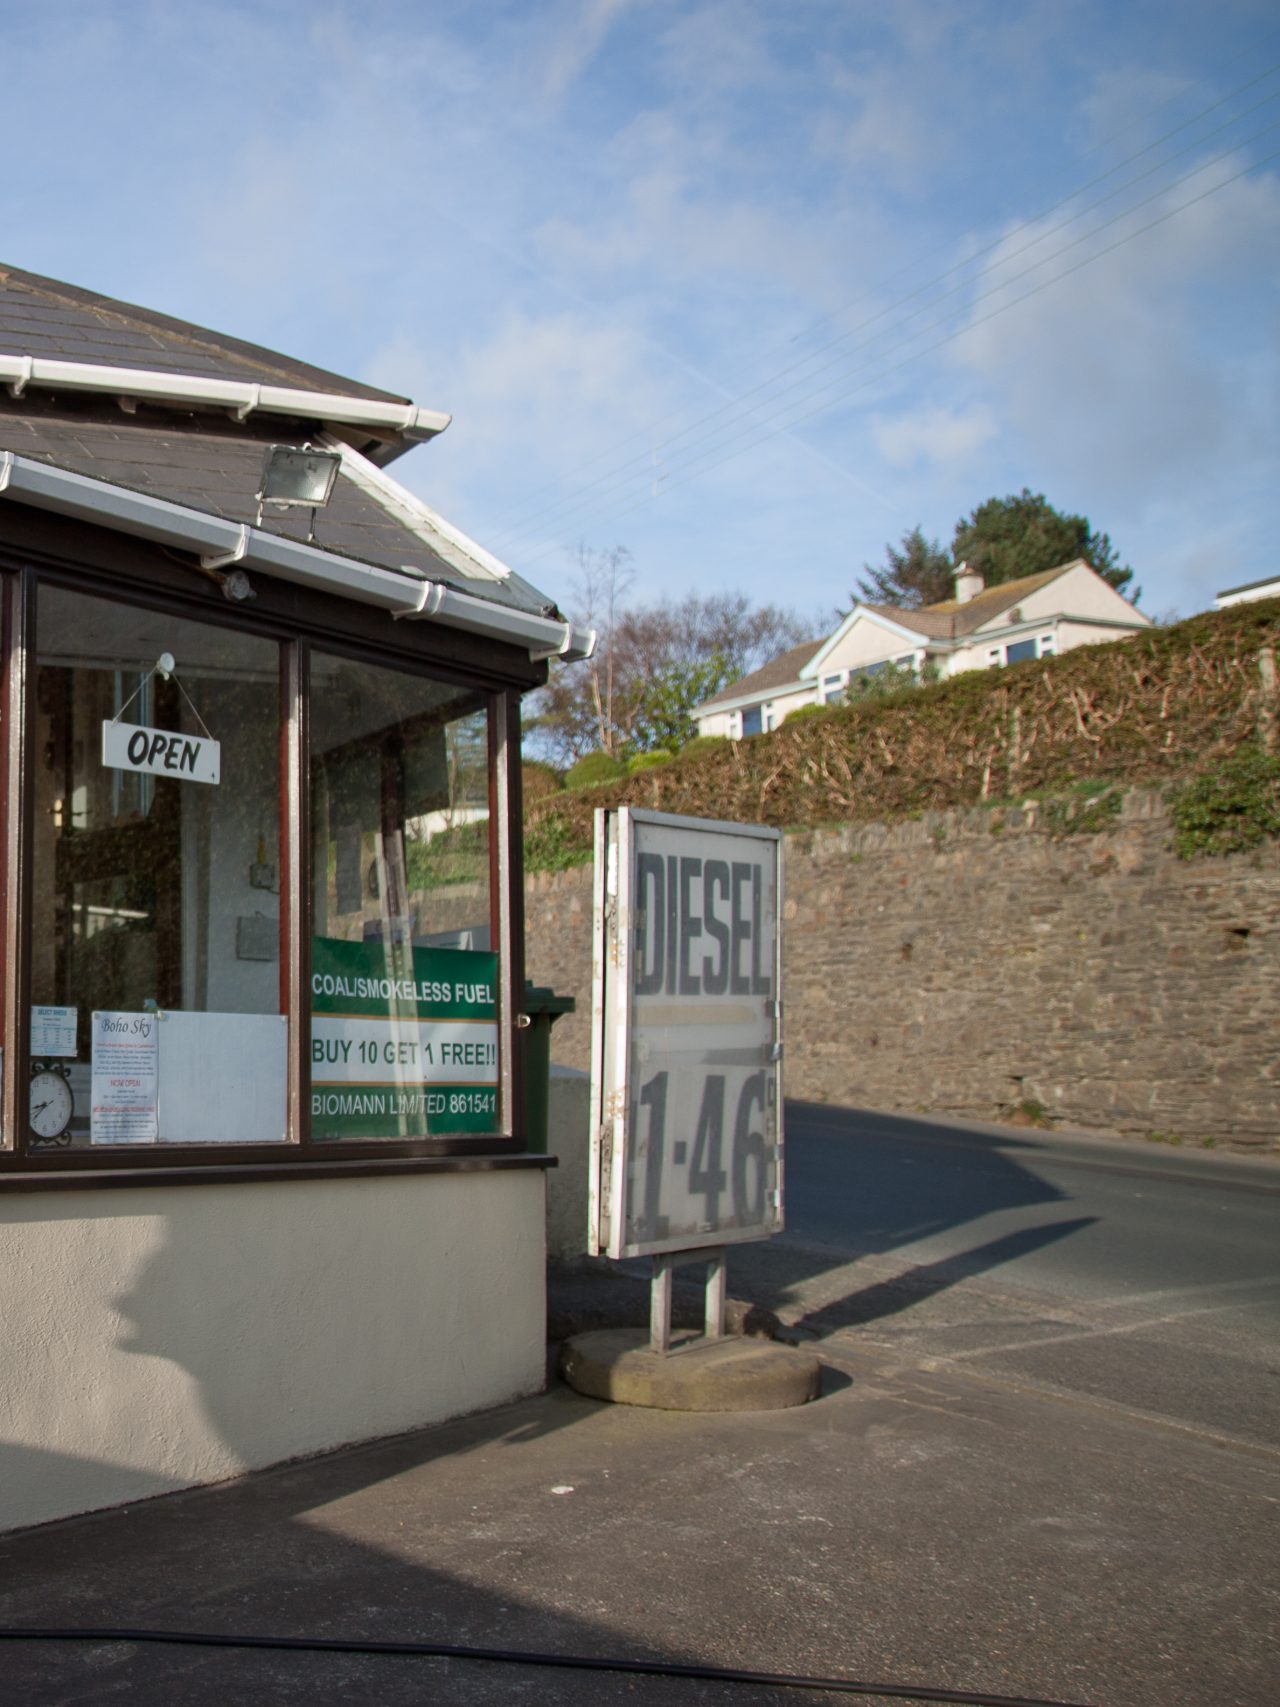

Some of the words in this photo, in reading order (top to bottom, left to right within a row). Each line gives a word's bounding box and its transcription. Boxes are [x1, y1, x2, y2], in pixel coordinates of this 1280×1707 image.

[128, 730, 201, 774] OPEN
[634, 852, 771, 996] DIESEL
[311, 974, 452, 1003] COAL/SMOKELESS
[455, 983, 495, 1004] FUEL
[101, 1017, 129, 1033] Boho
[131, 1018, 152, 1038] Sky
[312, 1039, 353, 1064] BUY
[359, 1041, 377, 1064] 10
[383, 1041, 418, 1064] GET
[425, 1042, 434, 1065] 1
[441, 1043, 496, 1066] FREE!!
[311, 1094, 385, 1115] BIOMANN
[390, 1094, 446, 1115] LIMITED
[450, 1094, 496, 1114] 861541
